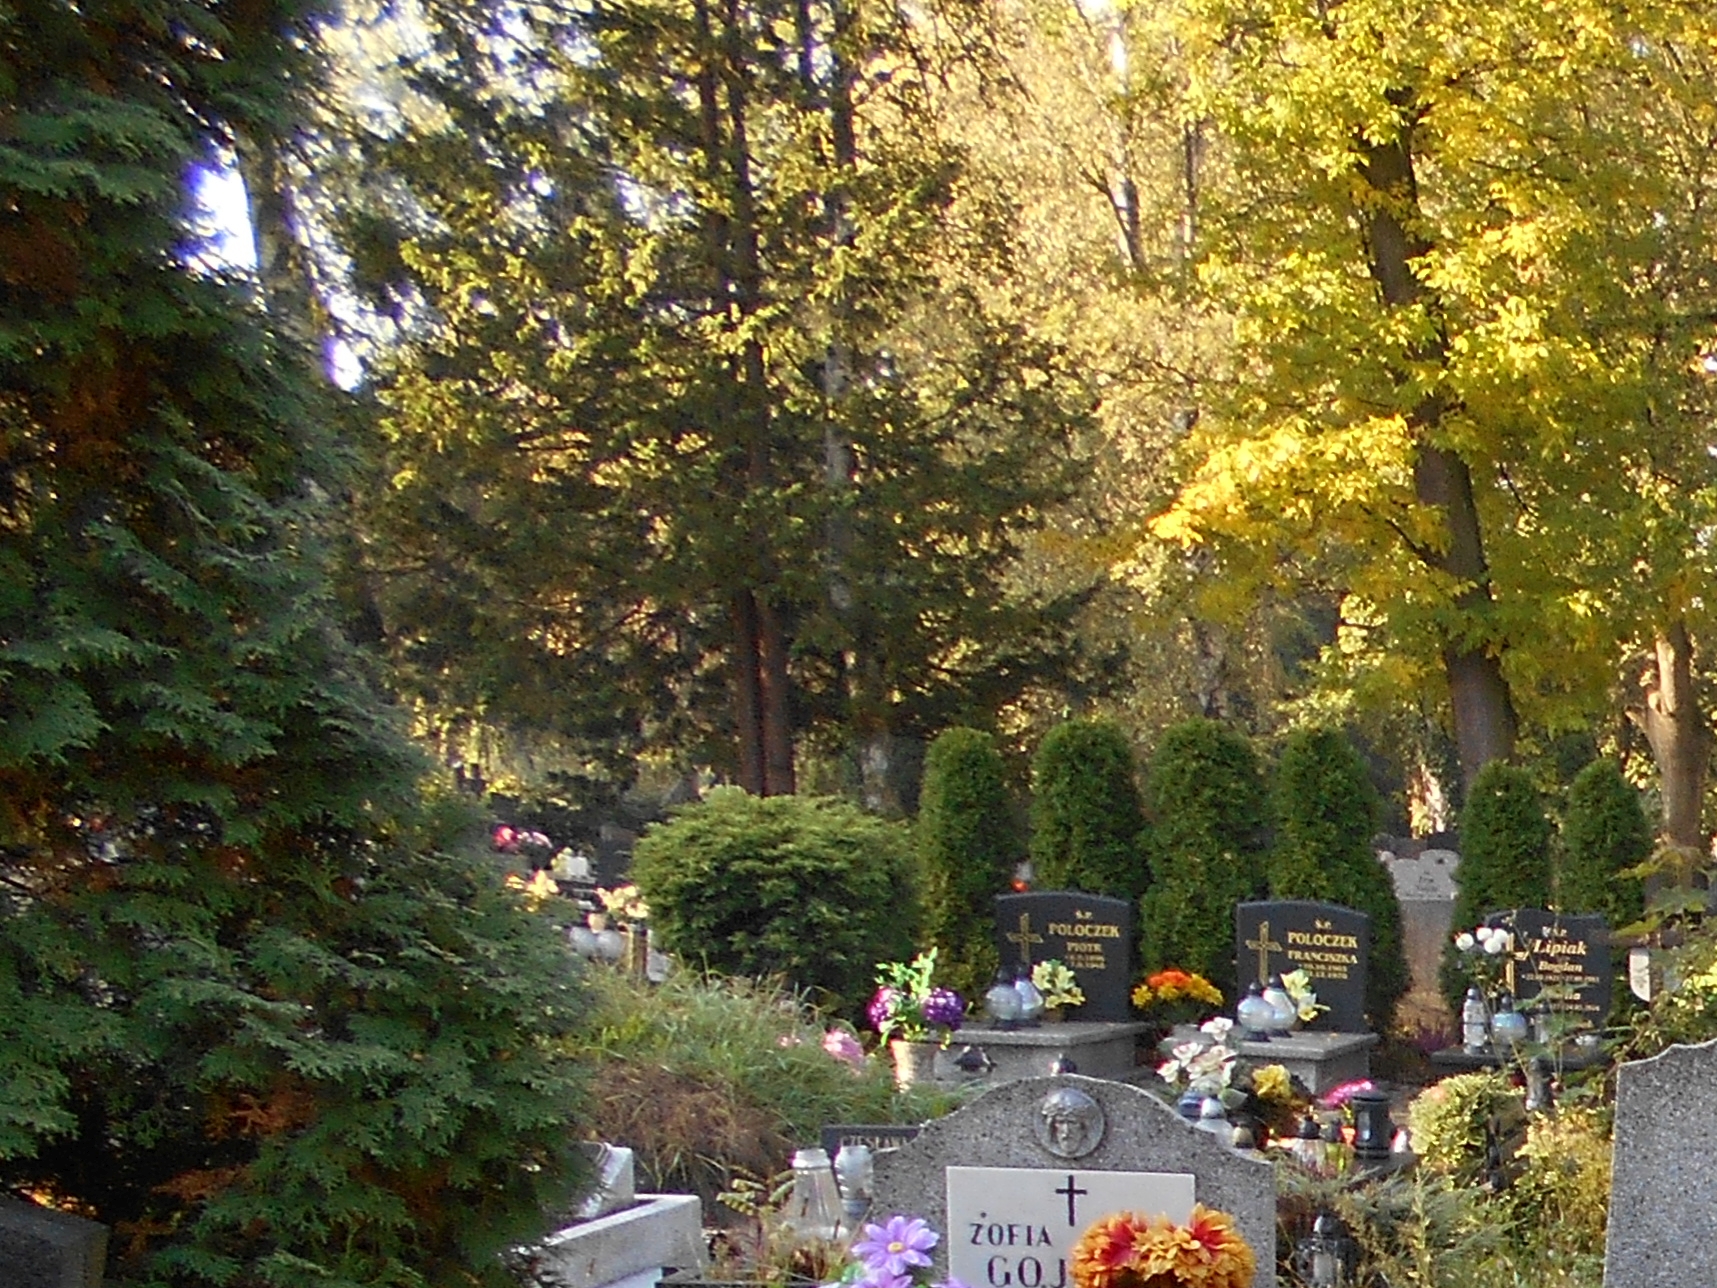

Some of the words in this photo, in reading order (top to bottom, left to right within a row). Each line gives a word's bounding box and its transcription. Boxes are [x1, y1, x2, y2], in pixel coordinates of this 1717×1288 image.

[1049, 924, 1120, 938] POLOCZEK
[1287, 932, 1358, 948] POLOCZEK
[1066, 942, 1102, 953] PIOTR
[1533, 939, 1587, 957] Lipiak
[1287, 951, 1358, 964] FRANCISZKA
